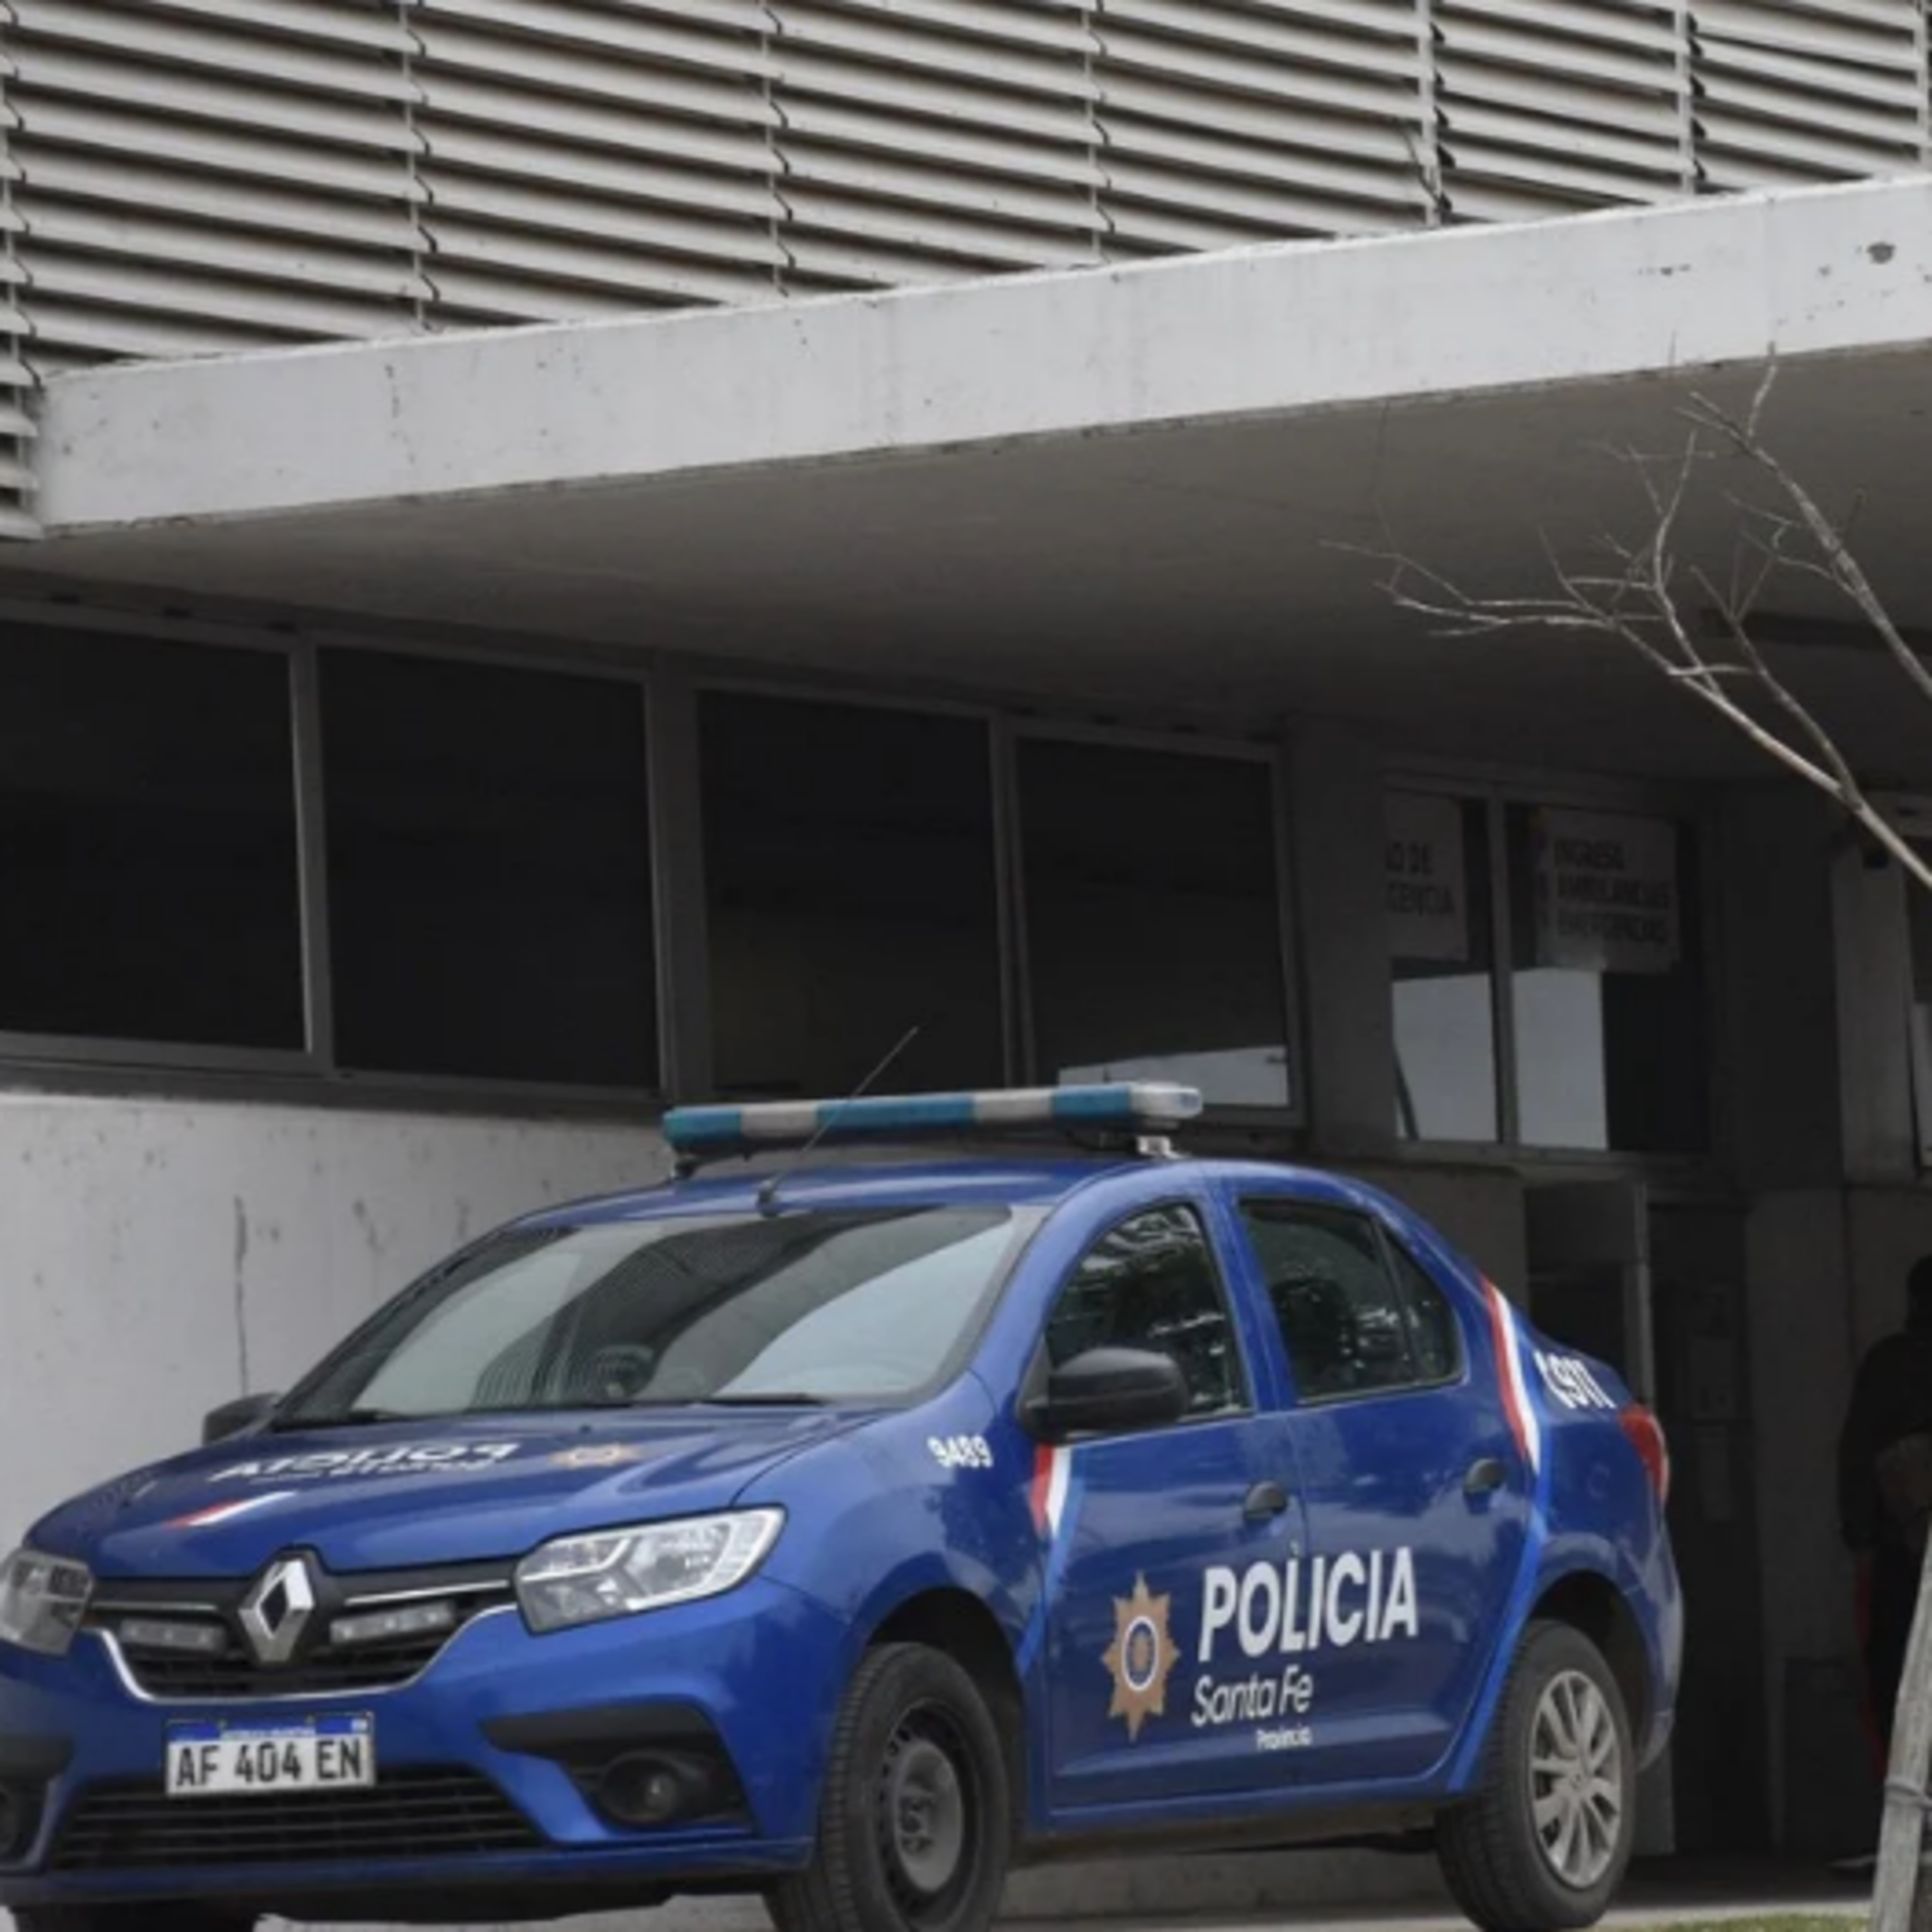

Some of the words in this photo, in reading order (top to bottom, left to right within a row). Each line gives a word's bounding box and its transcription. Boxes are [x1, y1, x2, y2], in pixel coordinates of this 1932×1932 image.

[1198, 1547, 1419, 1663] POLICIA
[1191, 1674, 1274, 1727] Santa
[1279, 1664, 1314, 1714] Fe
[176, 1745, 220, 1786] AF
[235, 1741, 302, 1783] 404
[316, 1738, 361, 1780] EN
